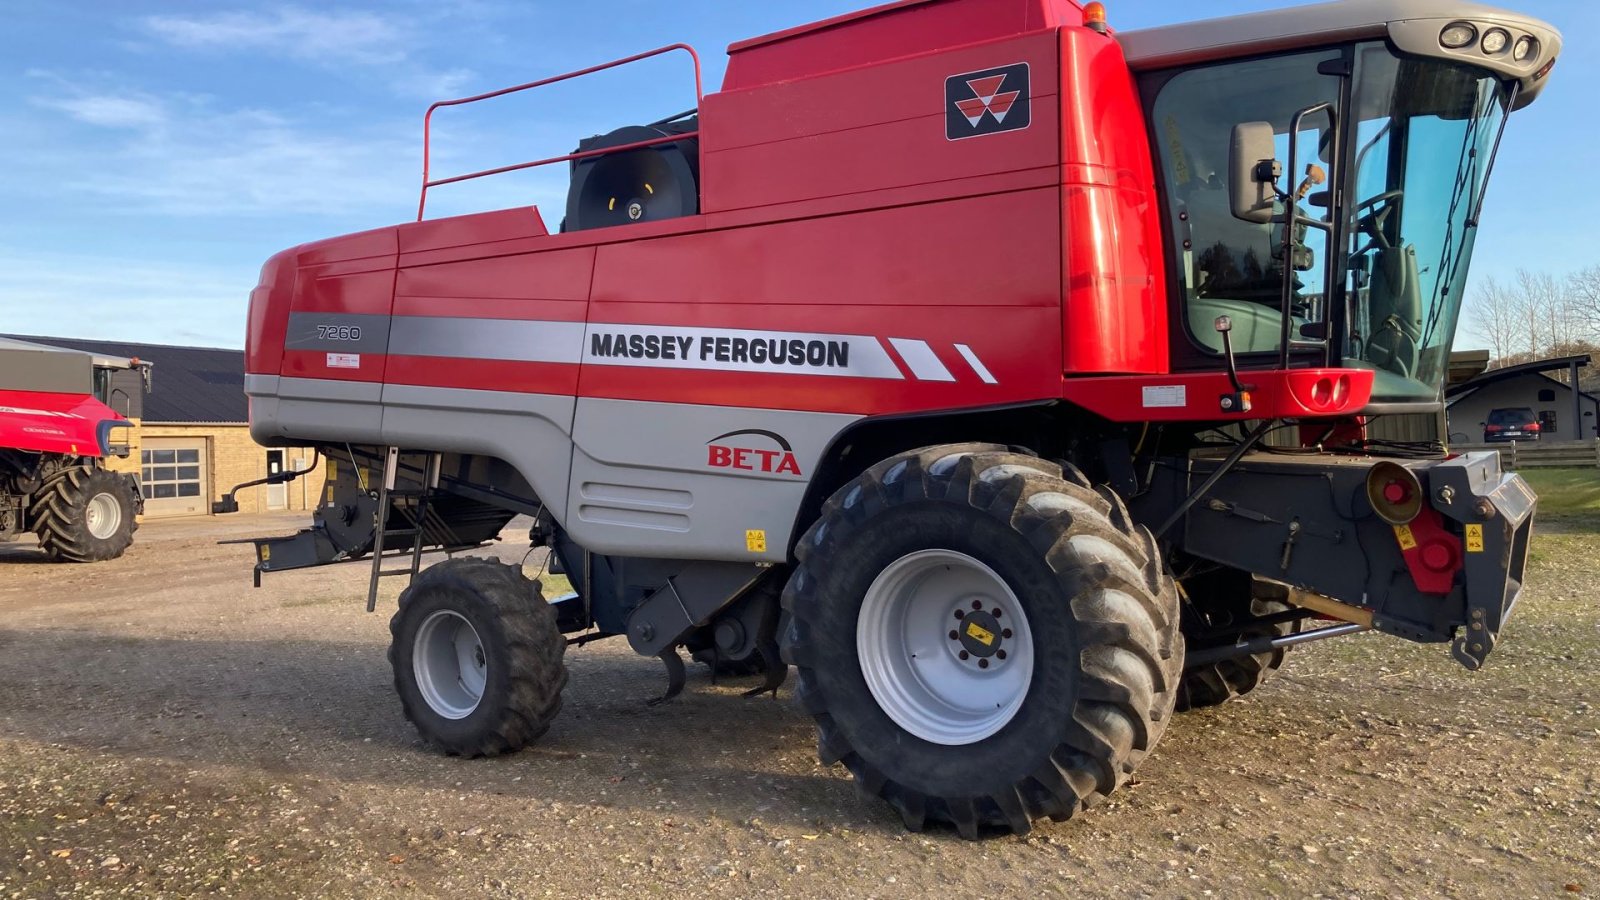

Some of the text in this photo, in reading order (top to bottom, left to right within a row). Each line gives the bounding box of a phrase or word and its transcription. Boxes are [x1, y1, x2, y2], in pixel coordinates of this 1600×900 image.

[317, 325, 361, 341] 7260
[591, 333, 849, 367] MASSEY FERGUSON
[707, 444, 802, 476] BETA
